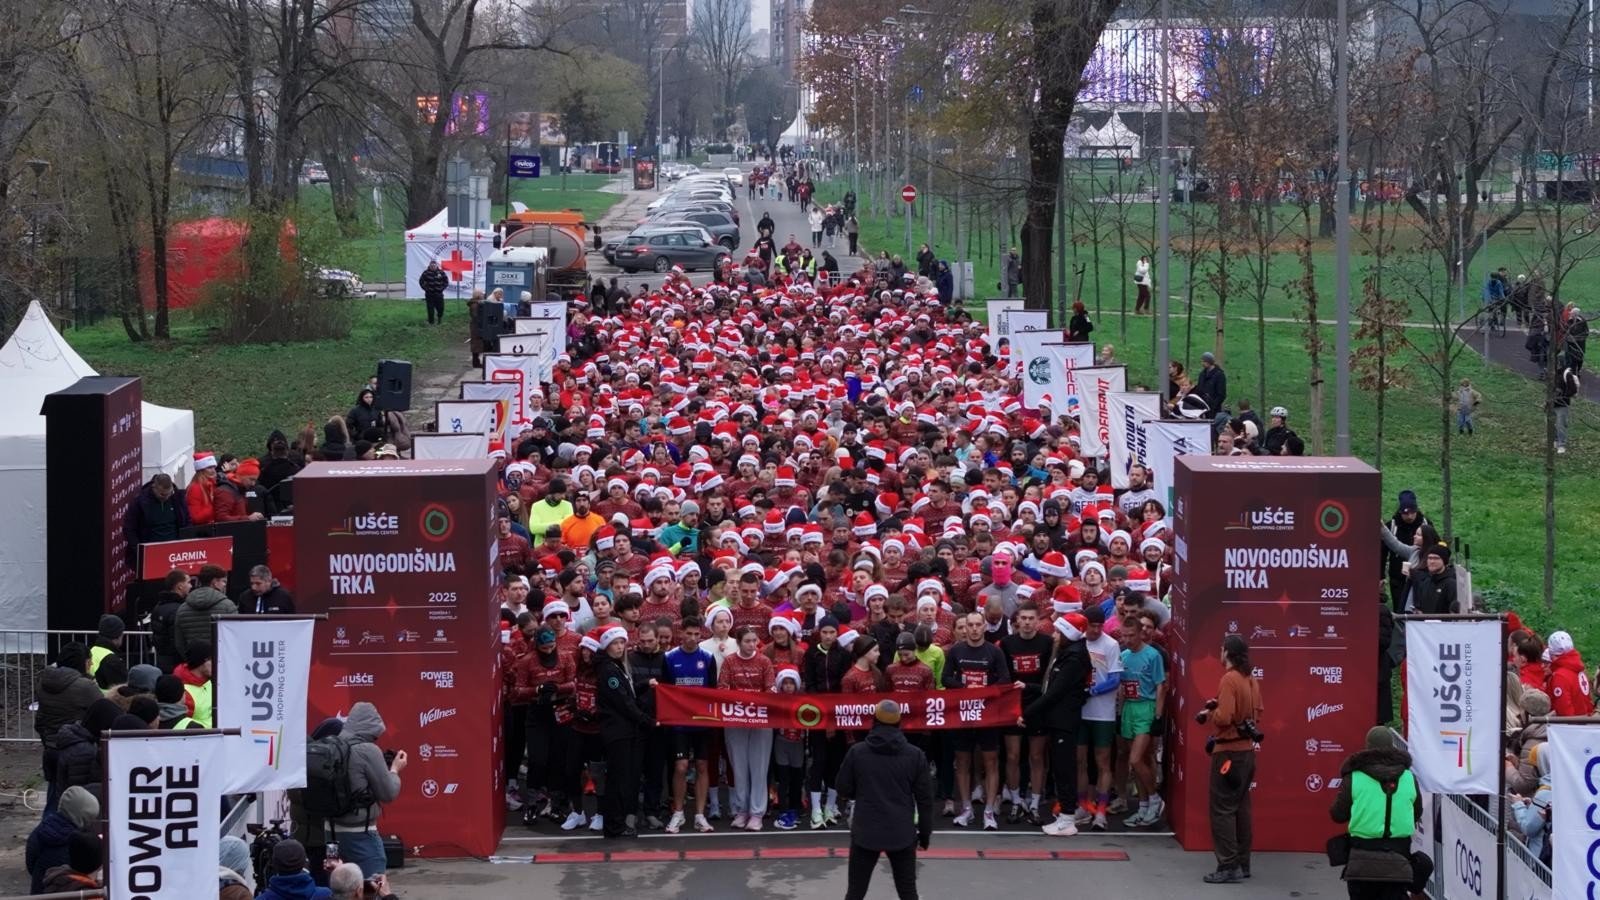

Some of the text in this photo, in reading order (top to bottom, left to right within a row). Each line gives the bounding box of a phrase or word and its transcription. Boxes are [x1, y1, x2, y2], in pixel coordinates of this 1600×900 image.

[1124, 404, 1136, 453] ПОШТА
[1136, 425, 1147, 466] РБИЈЕ
[355, 512, 399, 529] UŠĆE
[1252, 507, 1295, 525] UŠĆE
[168, 550, 207, 563] GARMIN
[329, 548, 456, 574] NOVOGODIŠNJA
[1225, 544, 1349, 569] NOVOGODIŠNJA
[330, 575, 375, 595] TRKA
[1225, 569, 1269, 589] TRKA
[428, 592, 457, 603] 2025
[1321, 588, 1349, 599] 2025
[349, 672, 374, 684] UŠĆE
[420, 671, 453, 680] POWER
[1251, 666, 1264, 677] ĆE
[1310, 667, 1343, 675] POWER
[1324, 675, 1343, 684] ADE
[244, 640, 275, 721] UŠĆE
[277, 640, 287, 721] SHOPPING CENTER
[435, 680, 453, 688] ADE
[1433, 643, 1462, 723] UŠĆE
[1464, 643, 1473, 722] SHOPPING CENTER
[721, 701, 769, 718] UŠĆE
[835, 702, 911, 716] NOVOGOJA
[926, 698, 946, 712] 20
[959, 699, 986, 711] UVEK
[1307, 702, 1344, 722] Wellness
[419, 707, 457, 728] Wellness
[722, 716, 748, 724] SHOPPING
[835, 715, 863, 727] TRKA
[926, 712, 946, 726] 25
[165, 764, 200, 849] ADE
[1455, 838, 1482, 897] rosa
